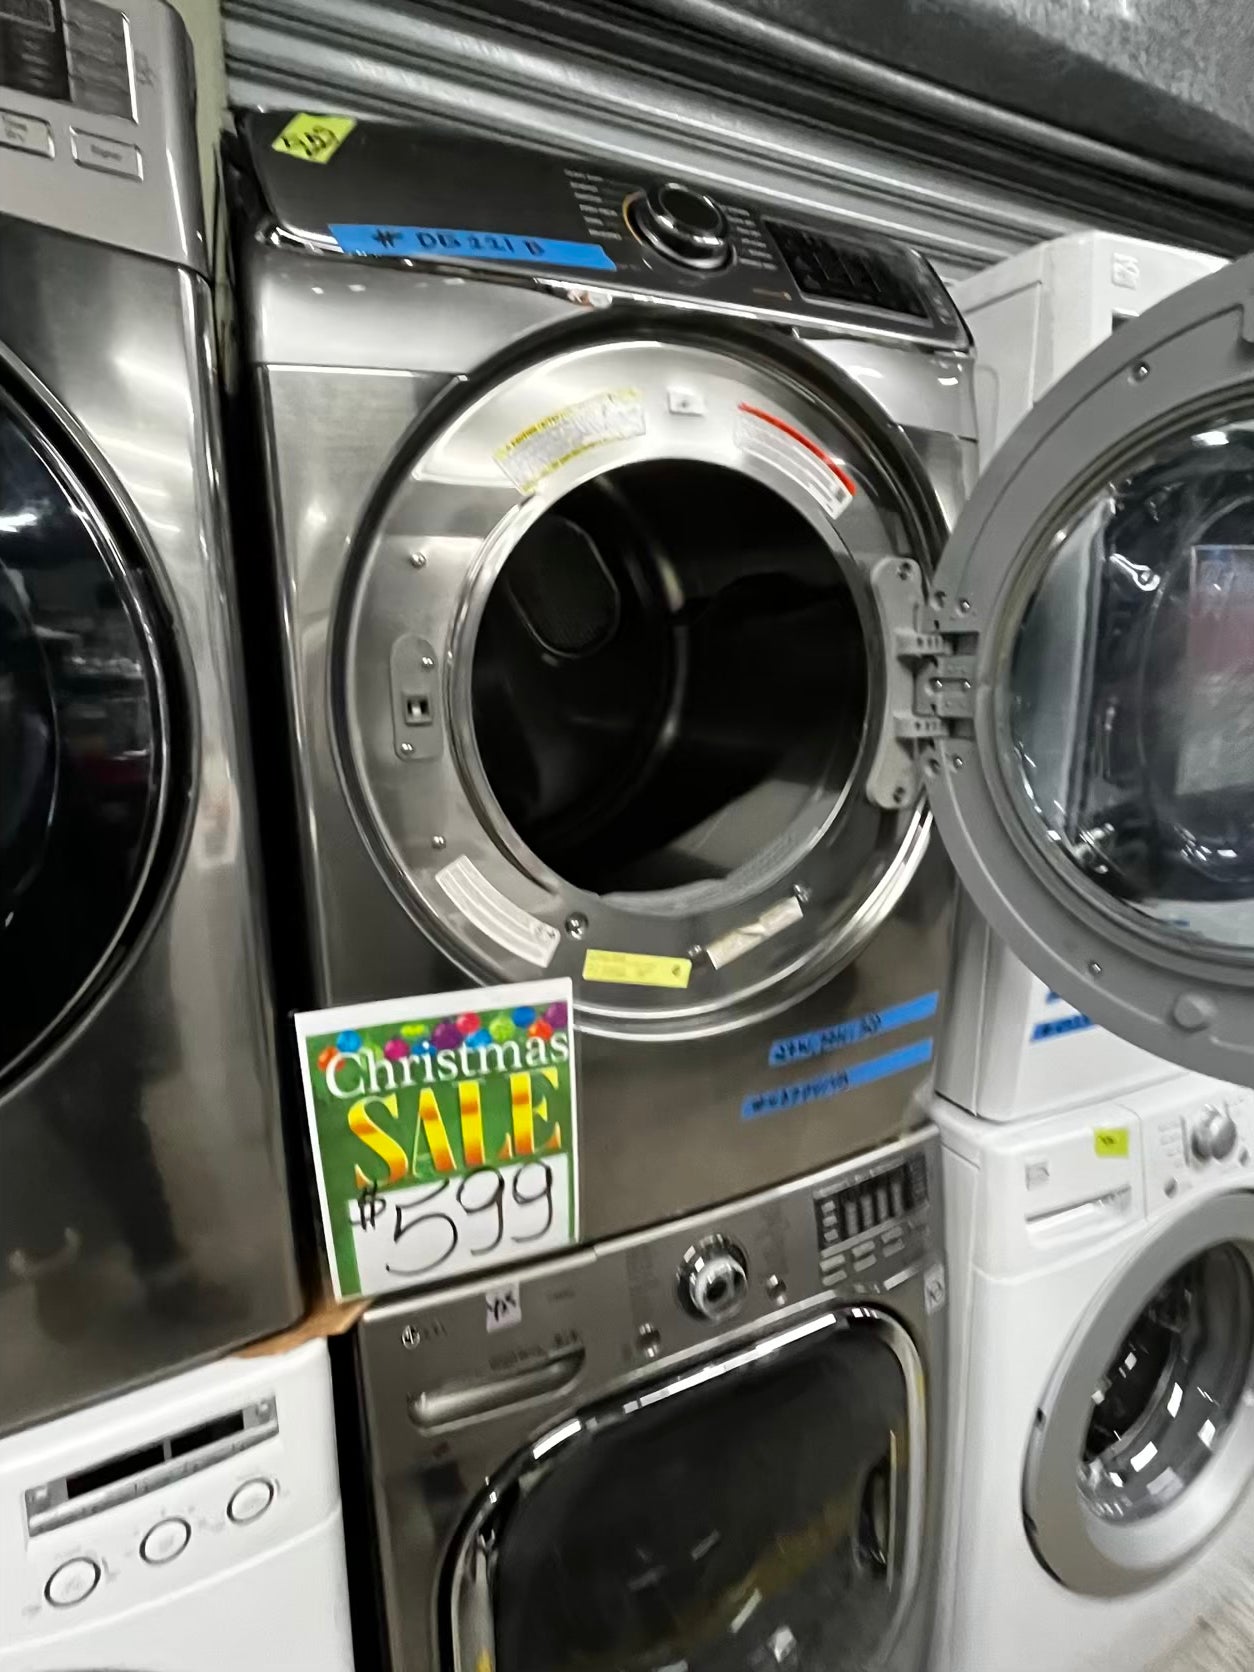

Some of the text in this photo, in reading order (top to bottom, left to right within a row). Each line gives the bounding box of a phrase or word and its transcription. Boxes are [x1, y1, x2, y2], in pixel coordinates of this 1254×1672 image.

[325, 1031, 569, 1099] Christmas
[346, 1066, 562, 1189] SALE
[349, 1161, 554, 1277] $599
